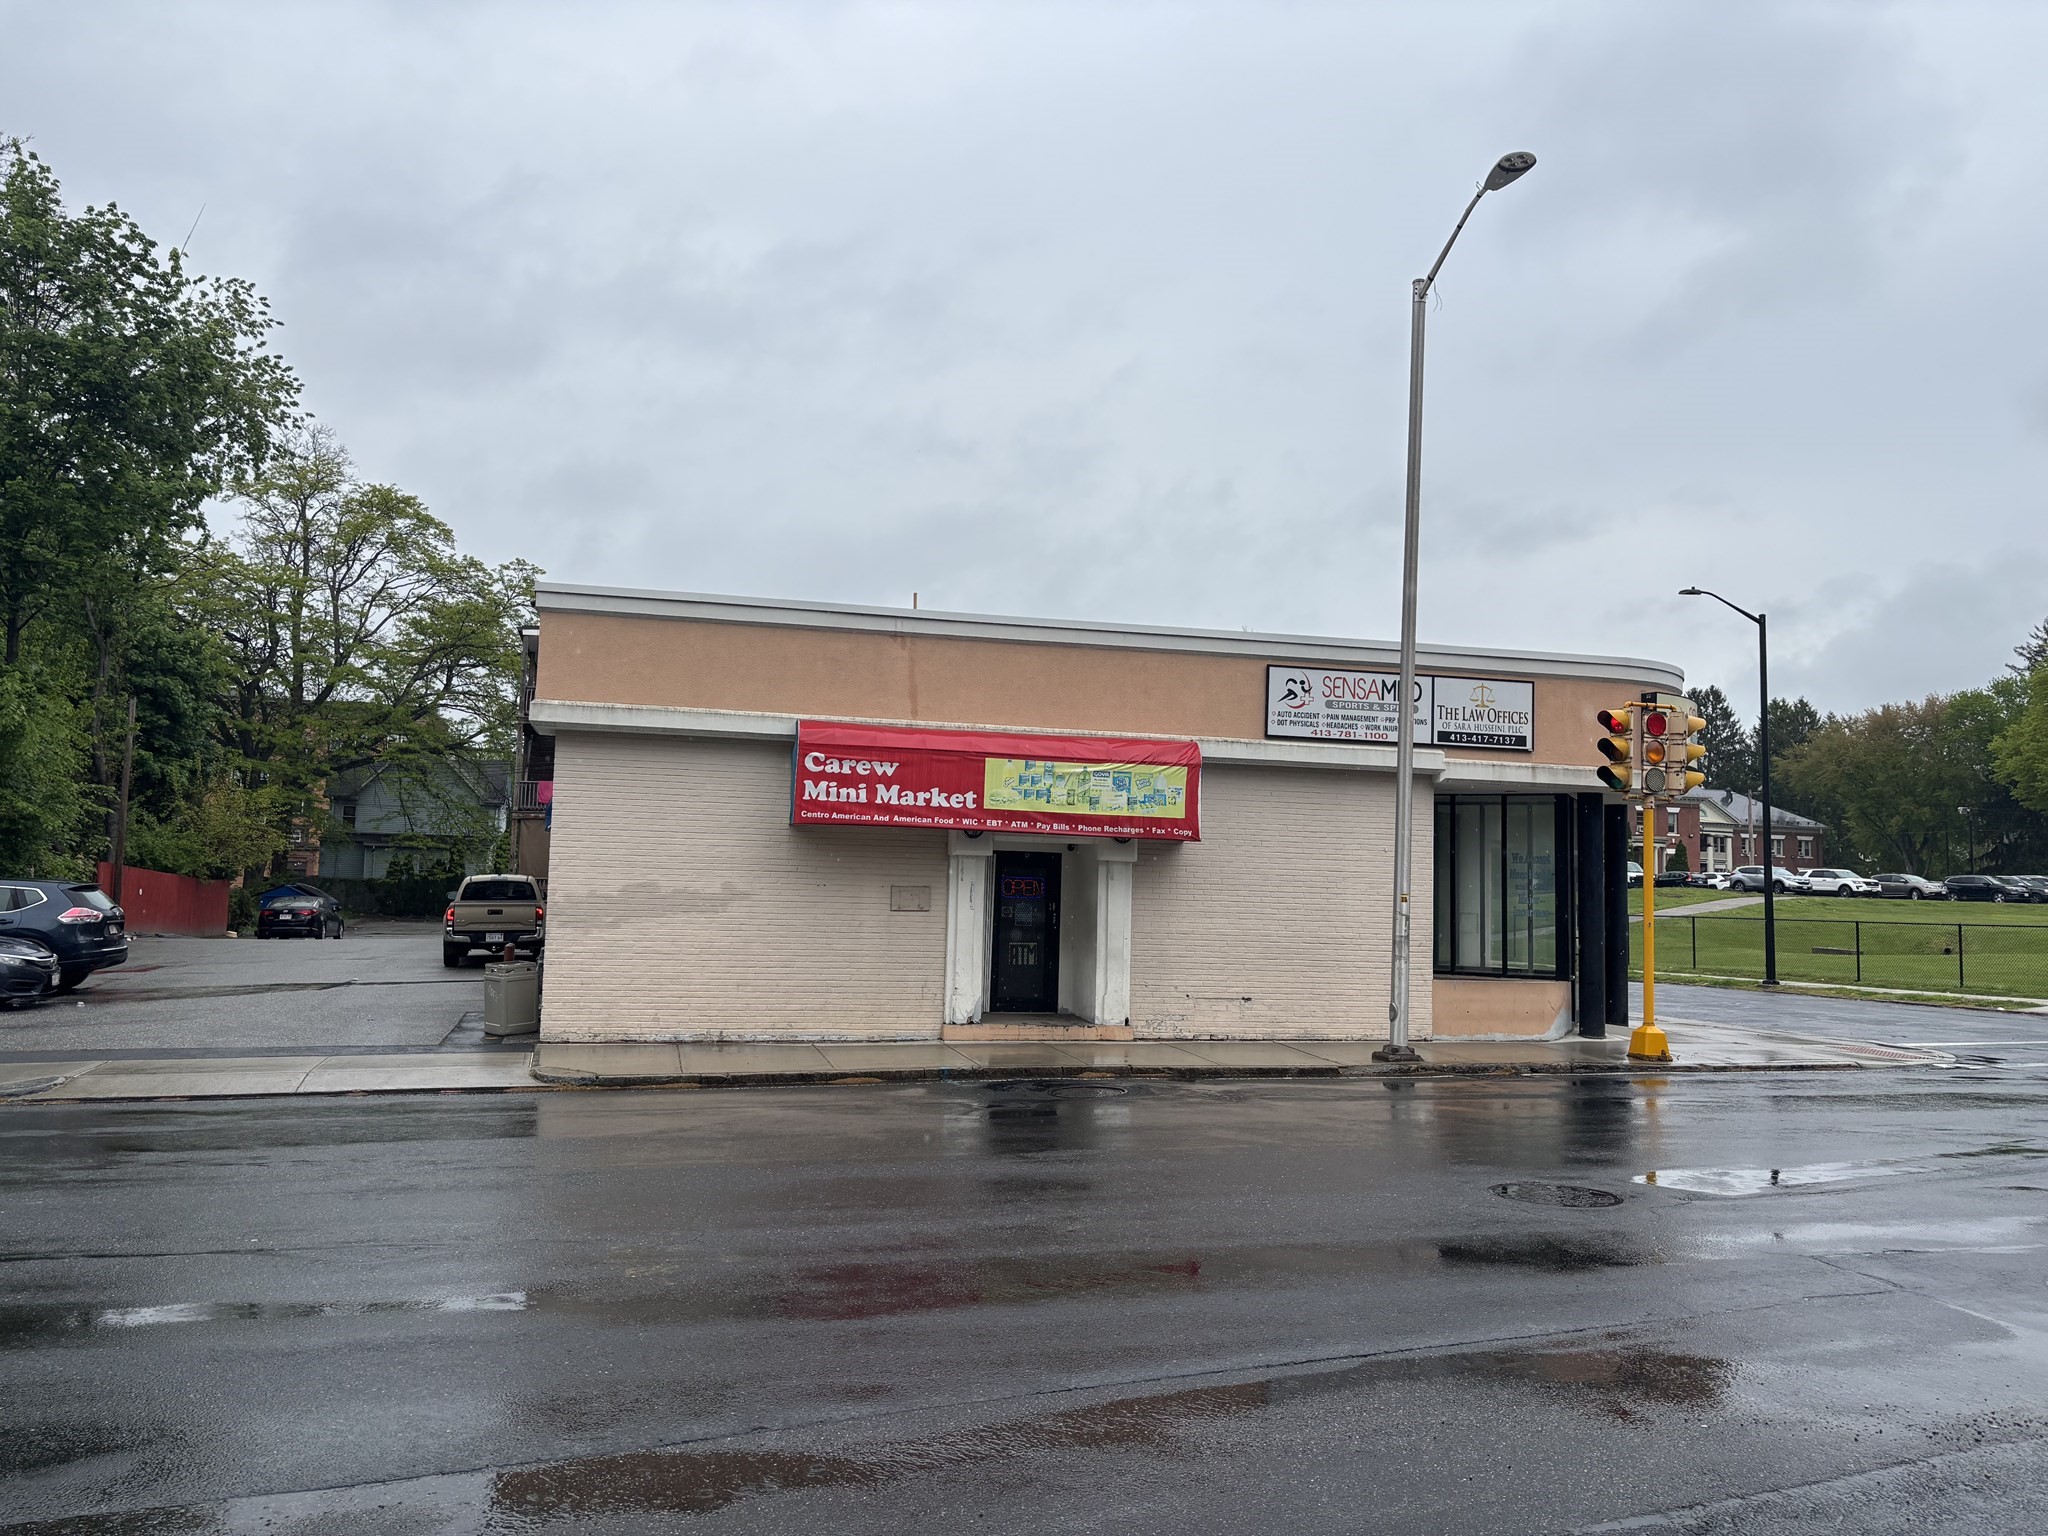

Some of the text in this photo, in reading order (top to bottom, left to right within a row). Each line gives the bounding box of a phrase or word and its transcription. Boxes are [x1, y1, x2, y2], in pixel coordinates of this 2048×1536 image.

[1322, 675, 1422, 702] SENSAMD
[1332, 701, 1399, 712] SPORTS & SPI
[1341, 714, 1379, 723] MANAGEMENT
[1276, 719, 1288, 727] DOT
[1289, 720, 1320, 728] PHYSICALS
[1326, 722, 1359, 730] HEADACHES
[1365, 724, 1381, 732] WORK
[1442, 721, 1451, 730] OF
[1454, 722, 1472, 731] SARA
[1508, 726, 1524, 734] PLLC
[1310, 728, 1389, 740] 413-781-1100
[1449, 733, 1516, 744] 413-417-7137
[804, 752, 900, 777] Carew
[802, 779, 978, 809] Mini Market
[801, 810, 1192, 836] Centro American And American Food WIC EBT ATM Pay Bills Phone Recharges Fax Copy
[1003, 879, 1044, 896] OPEN
